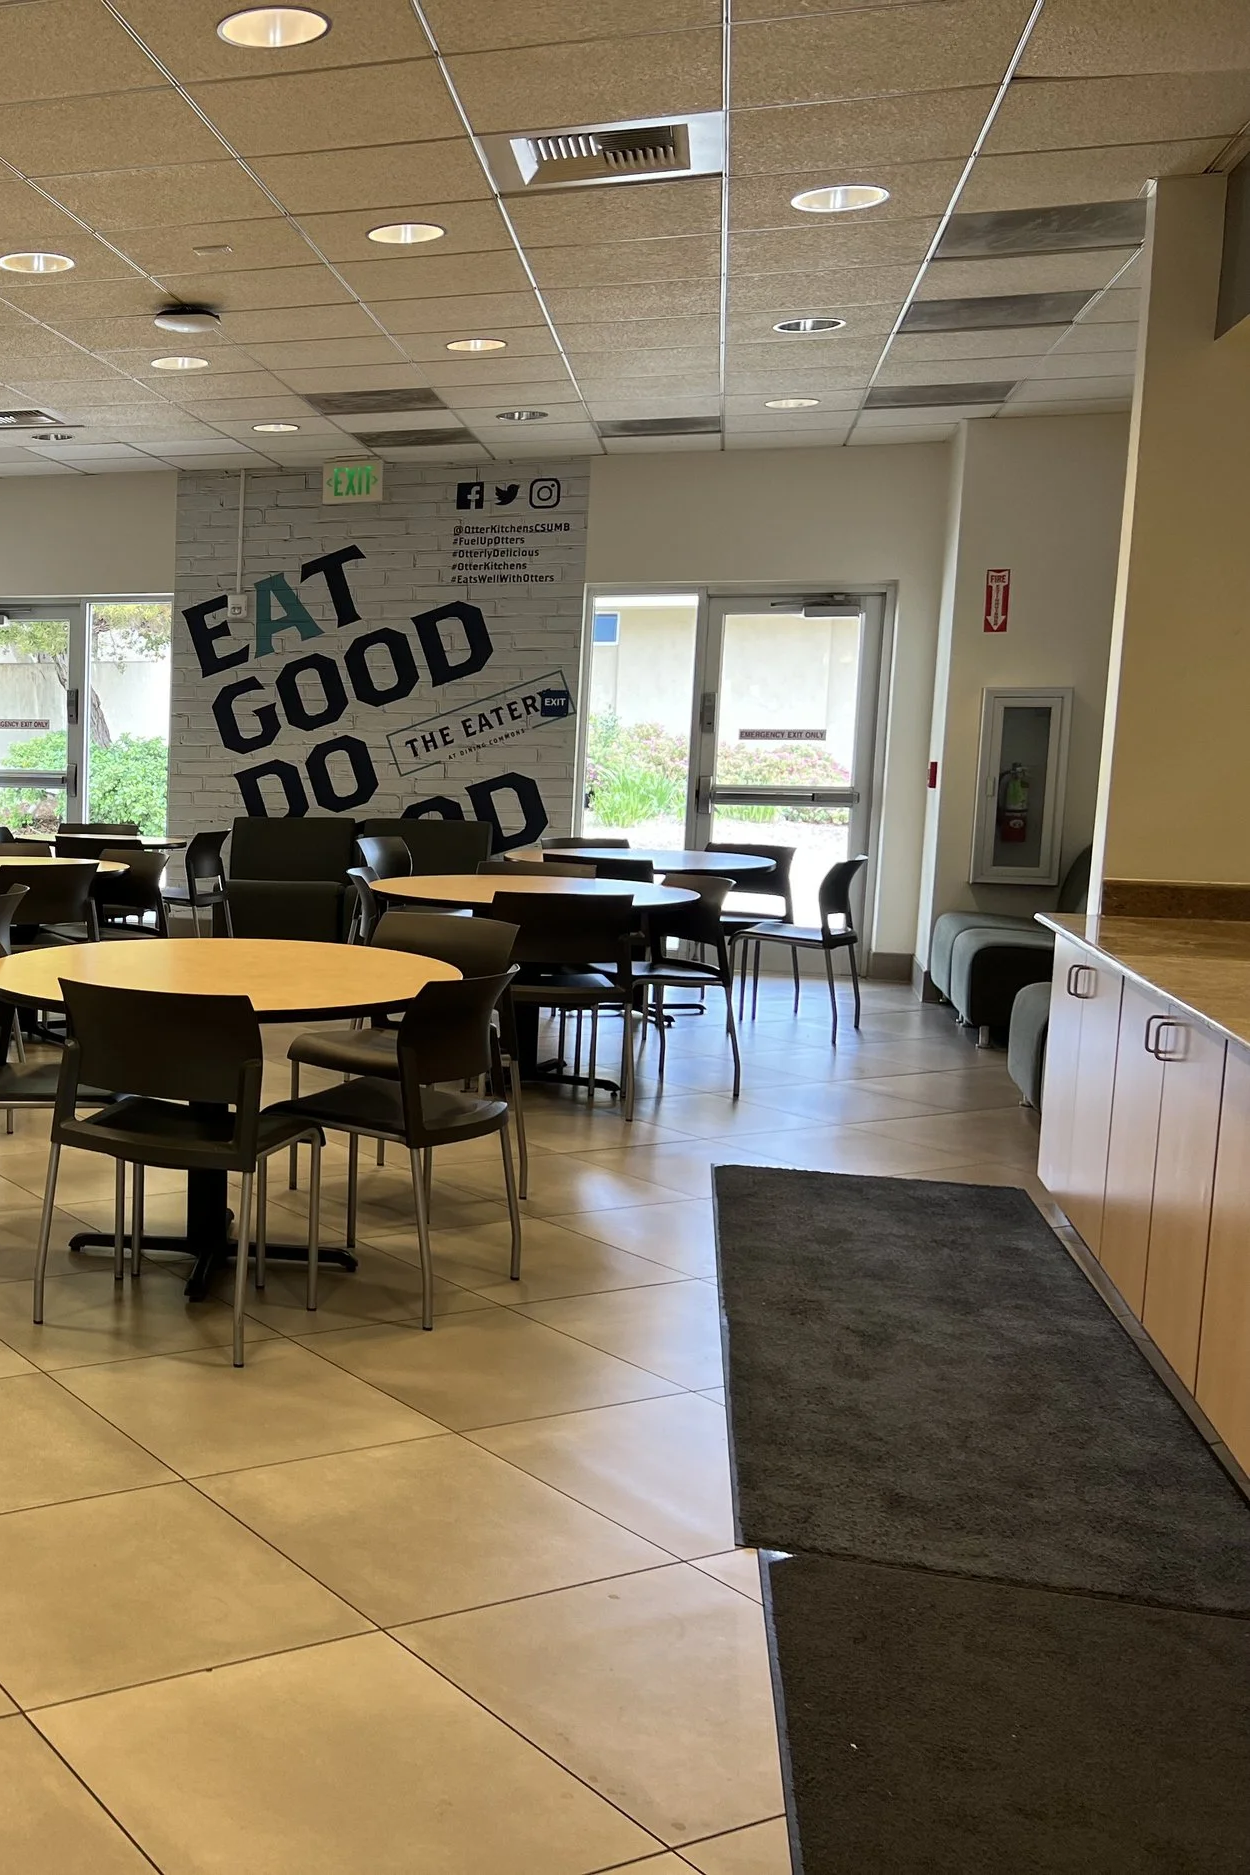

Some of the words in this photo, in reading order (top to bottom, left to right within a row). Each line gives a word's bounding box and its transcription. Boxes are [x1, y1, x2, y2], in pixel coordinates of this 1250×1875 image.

[334, 465, 374, 496] EXIT
[453, 523, 570, 536] @OtterKitchensCSUMB
[452, 536, 525, 547] #FuelUpOtters
[452, 548, 539, 560] #OtterlyDelicious
[451, 562, 527, 571] #OtterKitchens
[451, 574, 554, 584] #EatsWellWithOtters
[990, 575, 1006, 583] FIRE
[182, 544, 366, 678] EAT
[212, 600, 493, 754] GOOD
[544, 698, 566, 706] EXIT
[405, 727, 454, 757] THE
[460, 743, 486, 756] DINING
[489, 729, 525, 745] COMMONS
[233, 735, 379, 818] DO
